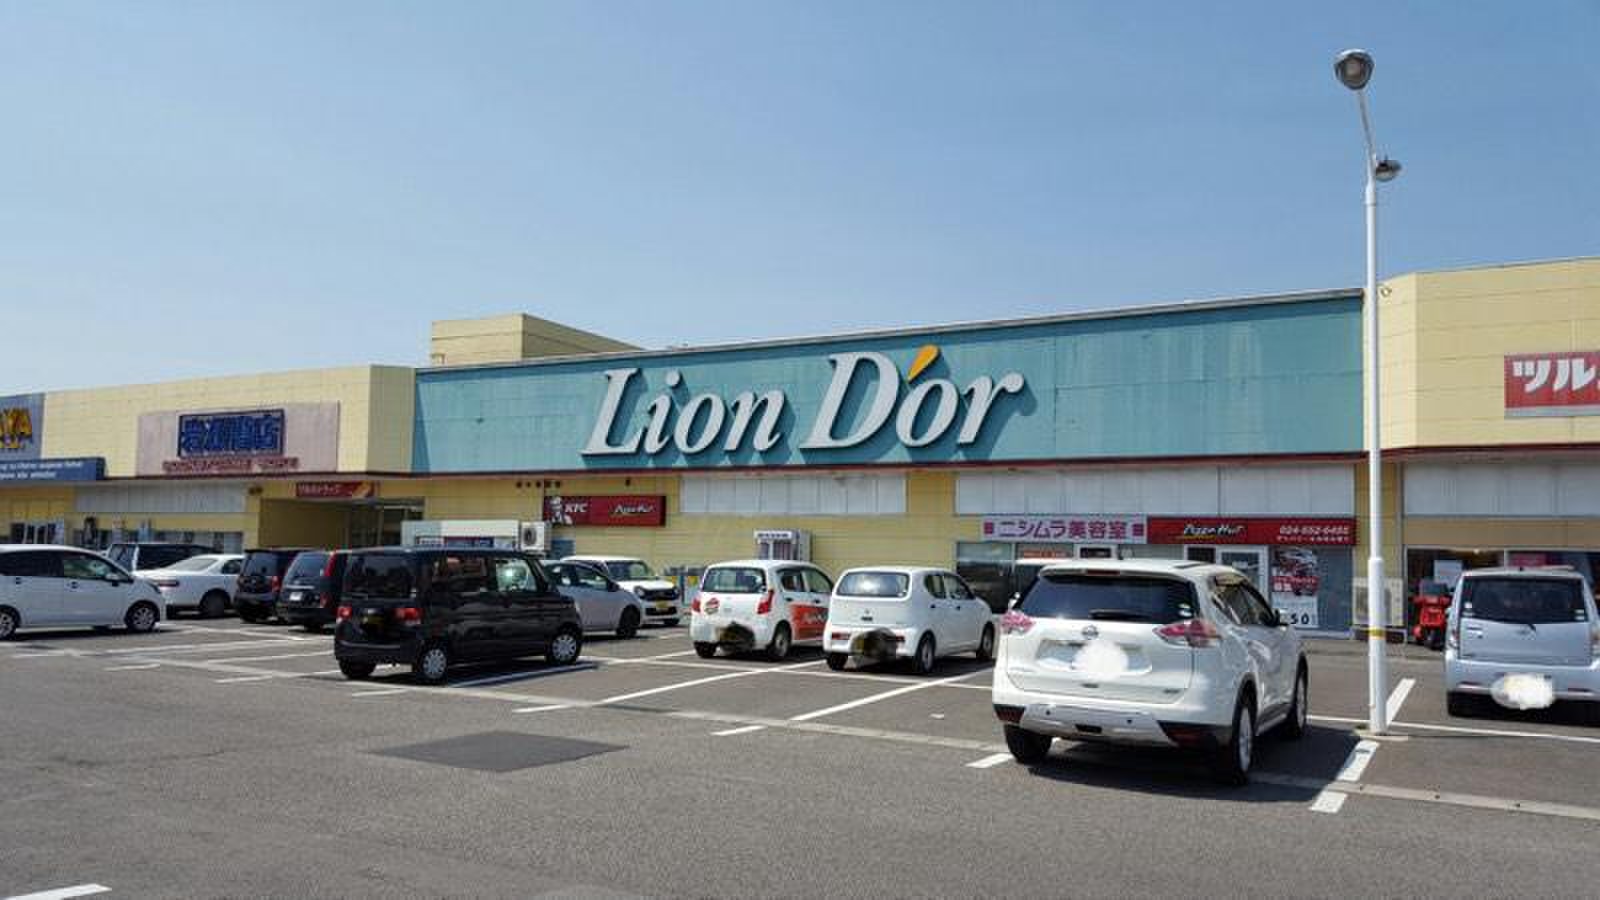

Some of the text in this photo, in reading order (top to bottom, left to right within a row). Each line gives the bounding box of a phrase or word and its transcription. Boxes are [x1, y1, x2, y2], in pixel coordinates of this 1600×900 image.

[1512, 358, 1600, 393] ツル
[580, 344, 1025, 456] Lion D'or
[999, 519, 1127, 539] ニシムラ美容室
